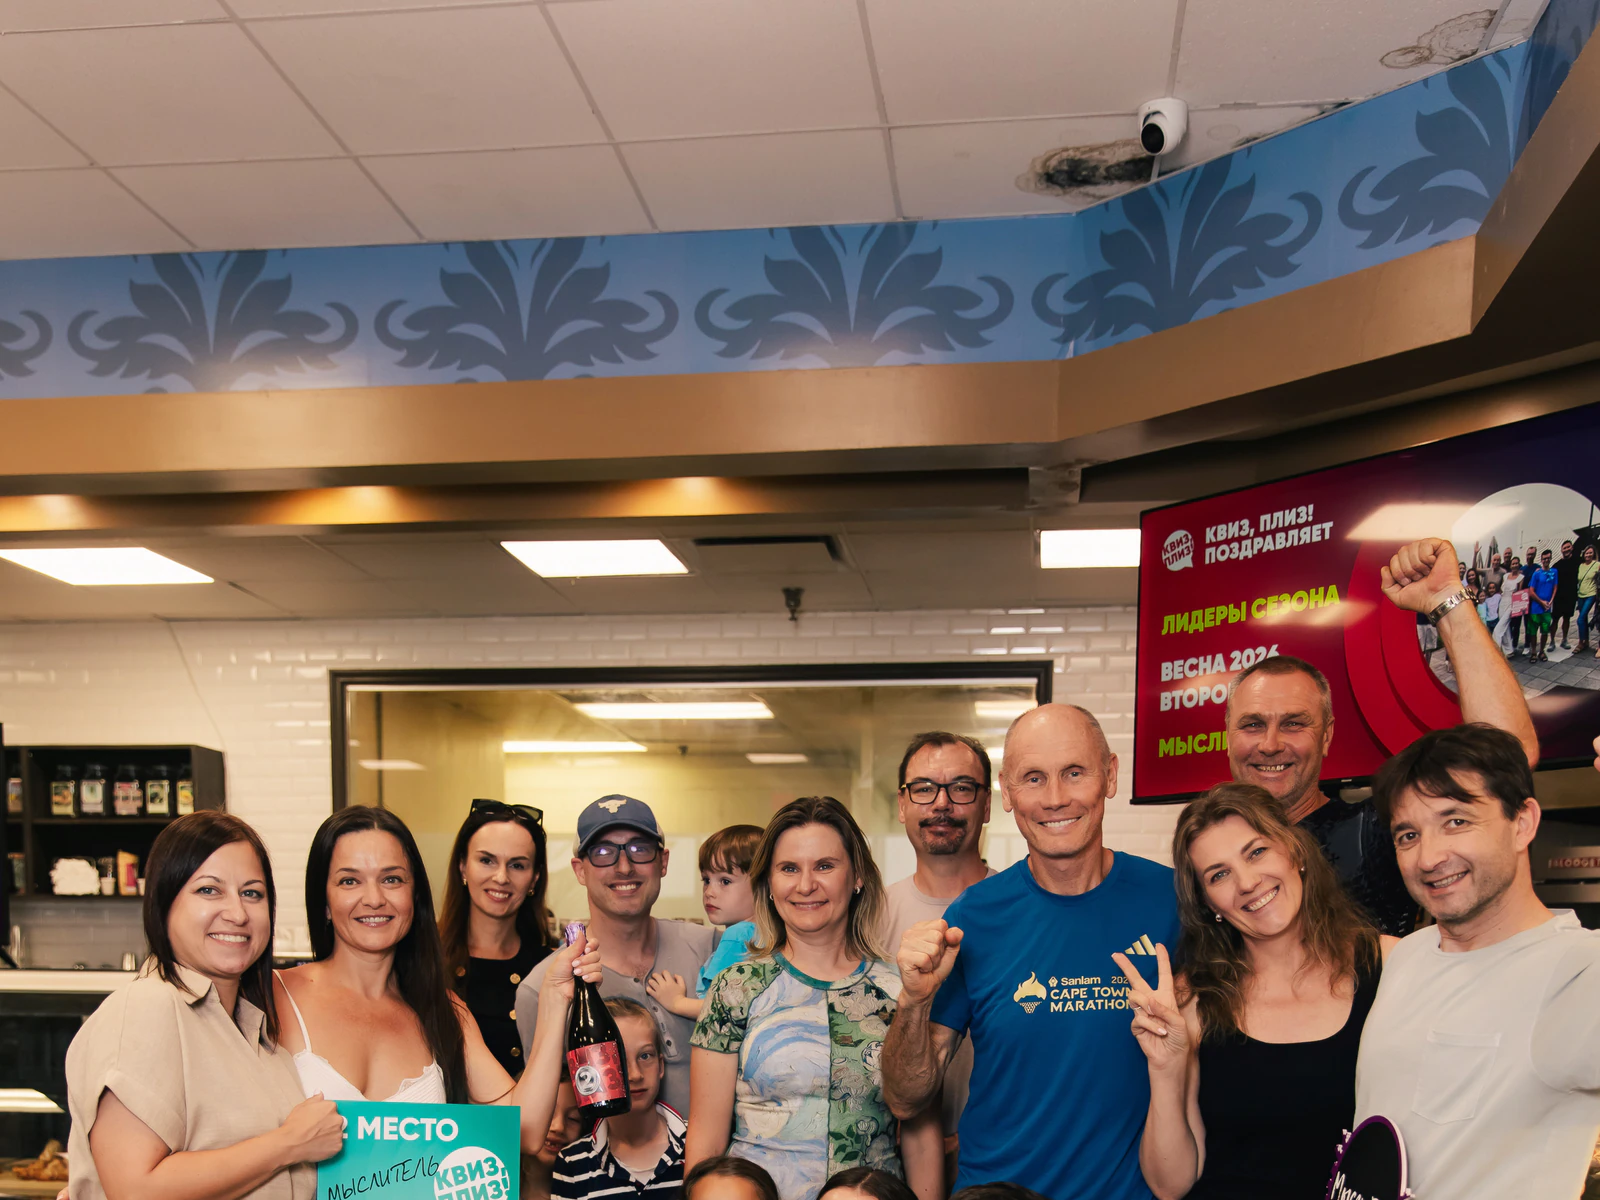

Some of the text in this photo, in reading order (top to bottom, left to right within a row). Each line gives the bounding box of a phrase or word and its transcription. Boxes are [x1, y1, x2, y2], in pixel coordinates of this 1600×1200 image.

[1205, 504, 1314, 544] КВИЗ, ПЛИЗ!
[1204, 521, 1334, 565] ПОЗДРАВЛЯЕТ
[1161, 584, 1341, 636] ЛИДЕРЫ СЕЗОНА
[1161, 653, 1226, 682] ВЕСНА
[1160, 682, 1231, 712] ВТОРО
[1050, 987, 1088, 1000] CAPE
[1061, 975, 1101, 986] Sanlam
[357, 1116, 459, 1142] МЕСТО
